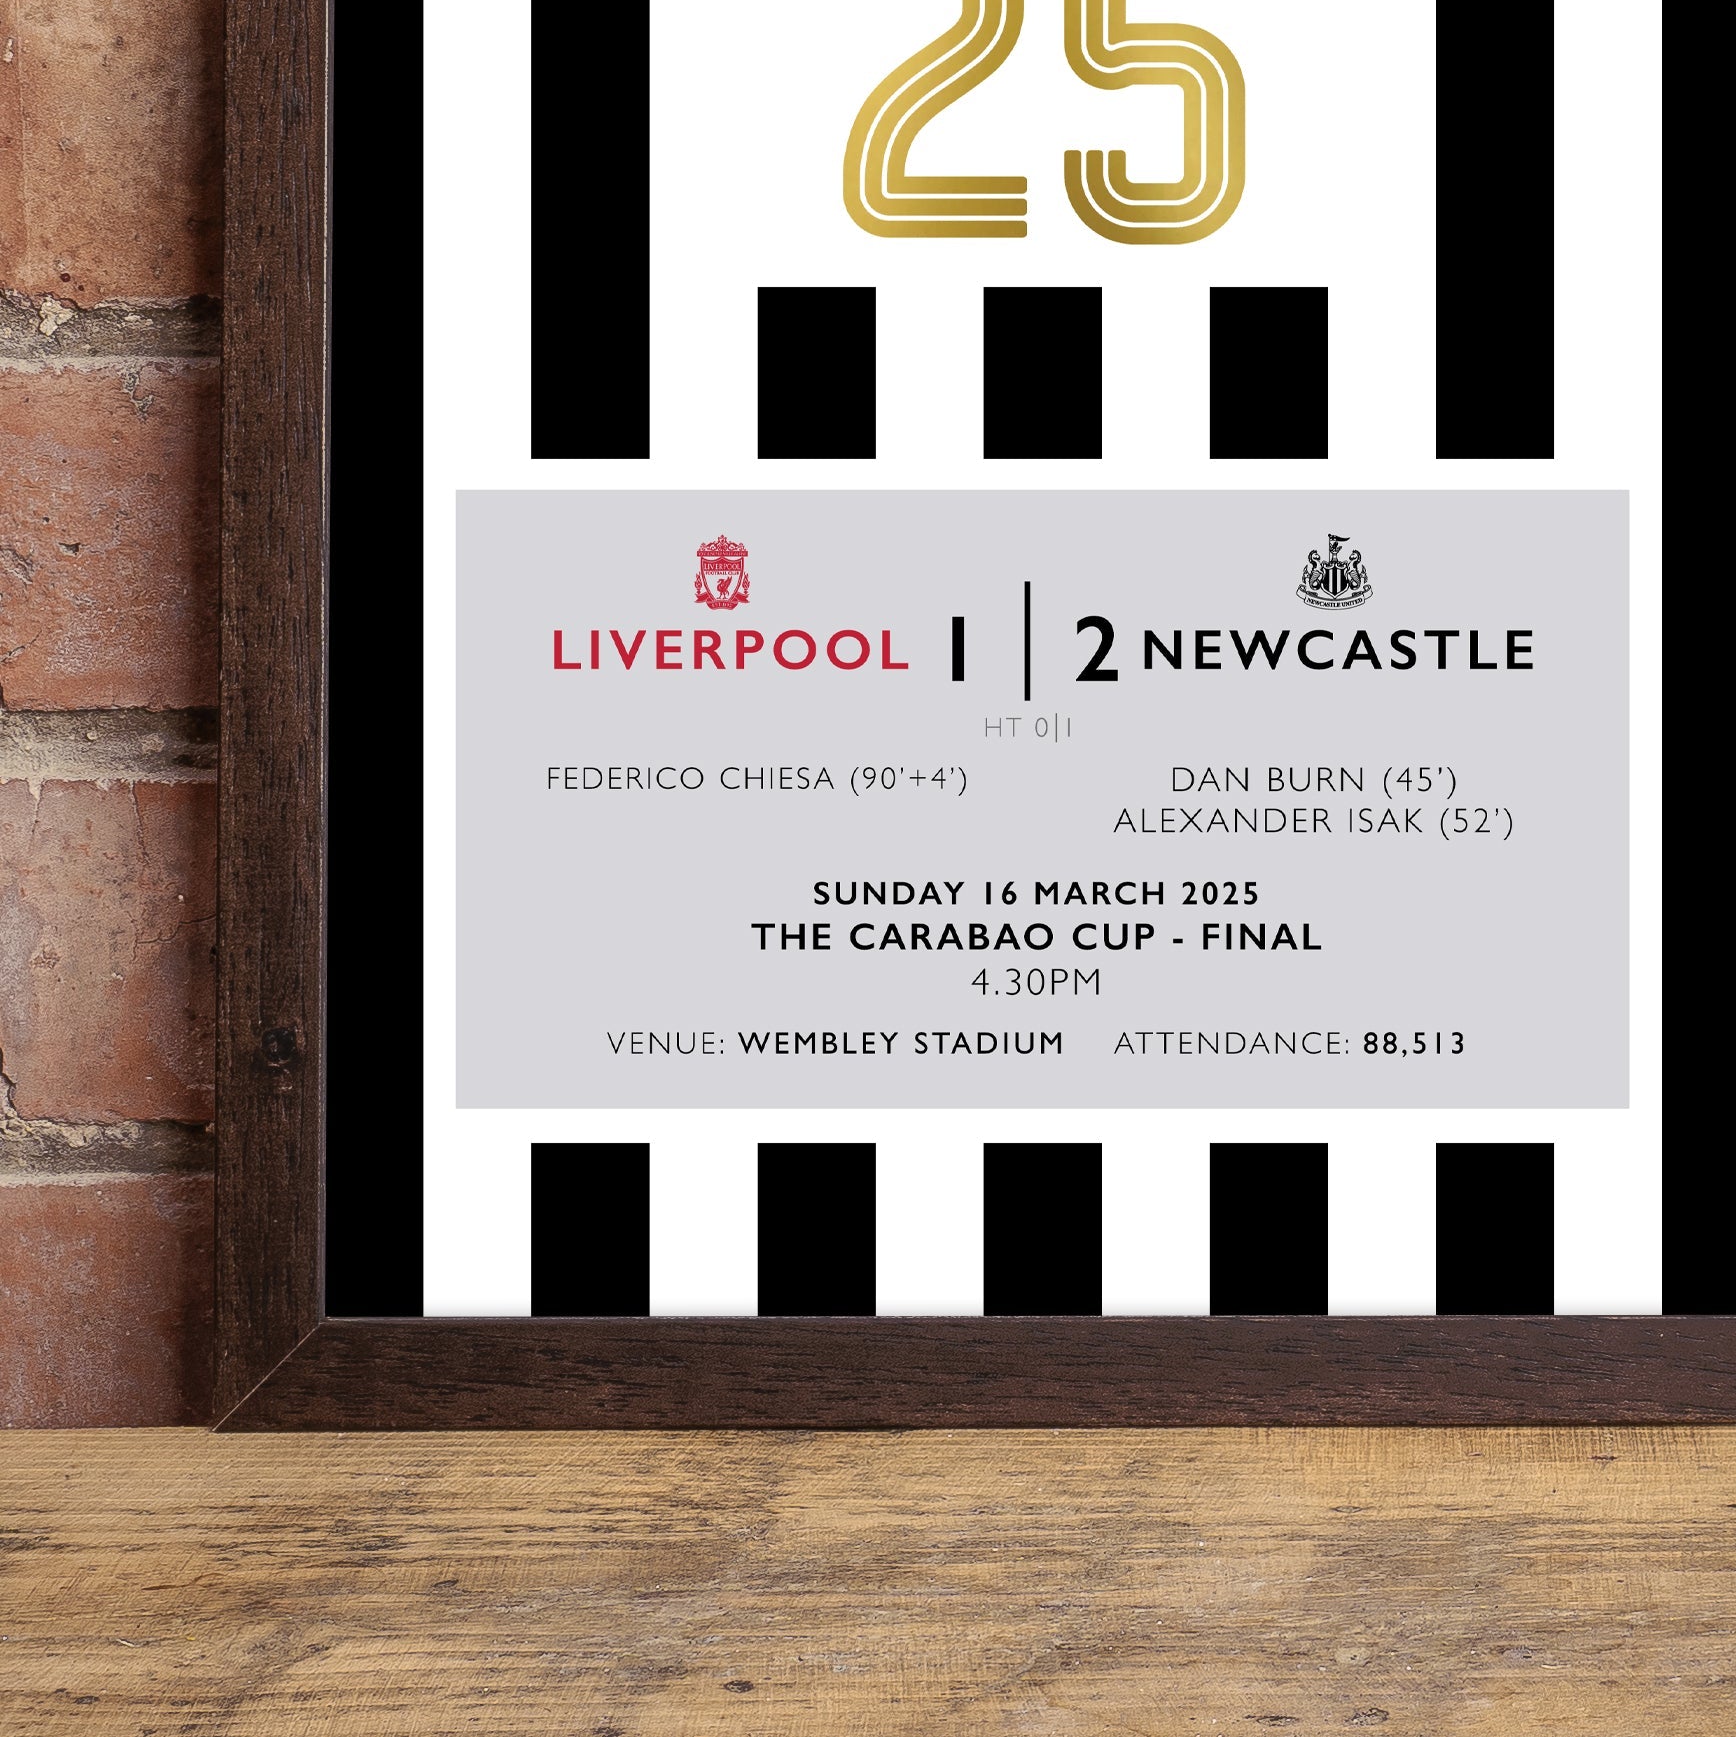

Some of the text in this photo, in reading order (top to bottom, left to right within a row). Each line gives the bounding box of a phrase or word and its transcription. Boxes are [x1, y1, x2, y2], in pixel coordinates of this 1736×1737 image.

[553, 614, 1533, 683] LIVERPOOL 1 2 NEWCASTLE
[985, 716, 1023, 738] HT
[547, 766, 704, 790] FEDERICO
[720, 766, 834, 790] CHIESA
[1173, 766, 1457, 800] DAN BURN (45')
[1113, 807, 1513, 841] ALEXANDER ISAK (52')
[813, 881, 1259, 906] SUNDAY 16 MARCH 2025
[751, 923, 830, 951] THE
[849, 923, 1054, 951] CARABAO
[1072, 923, 1155, 951] CUP
[1203, 923, 1321, 951] FINAL
[970, 967, 1100, 996] 4.30PM
[606, 1031, 1063, 1055] VENUE: WEMBLEY STADIUM
[1113, 1031, 1464, 1058] ATTENDANCE: 88,513
